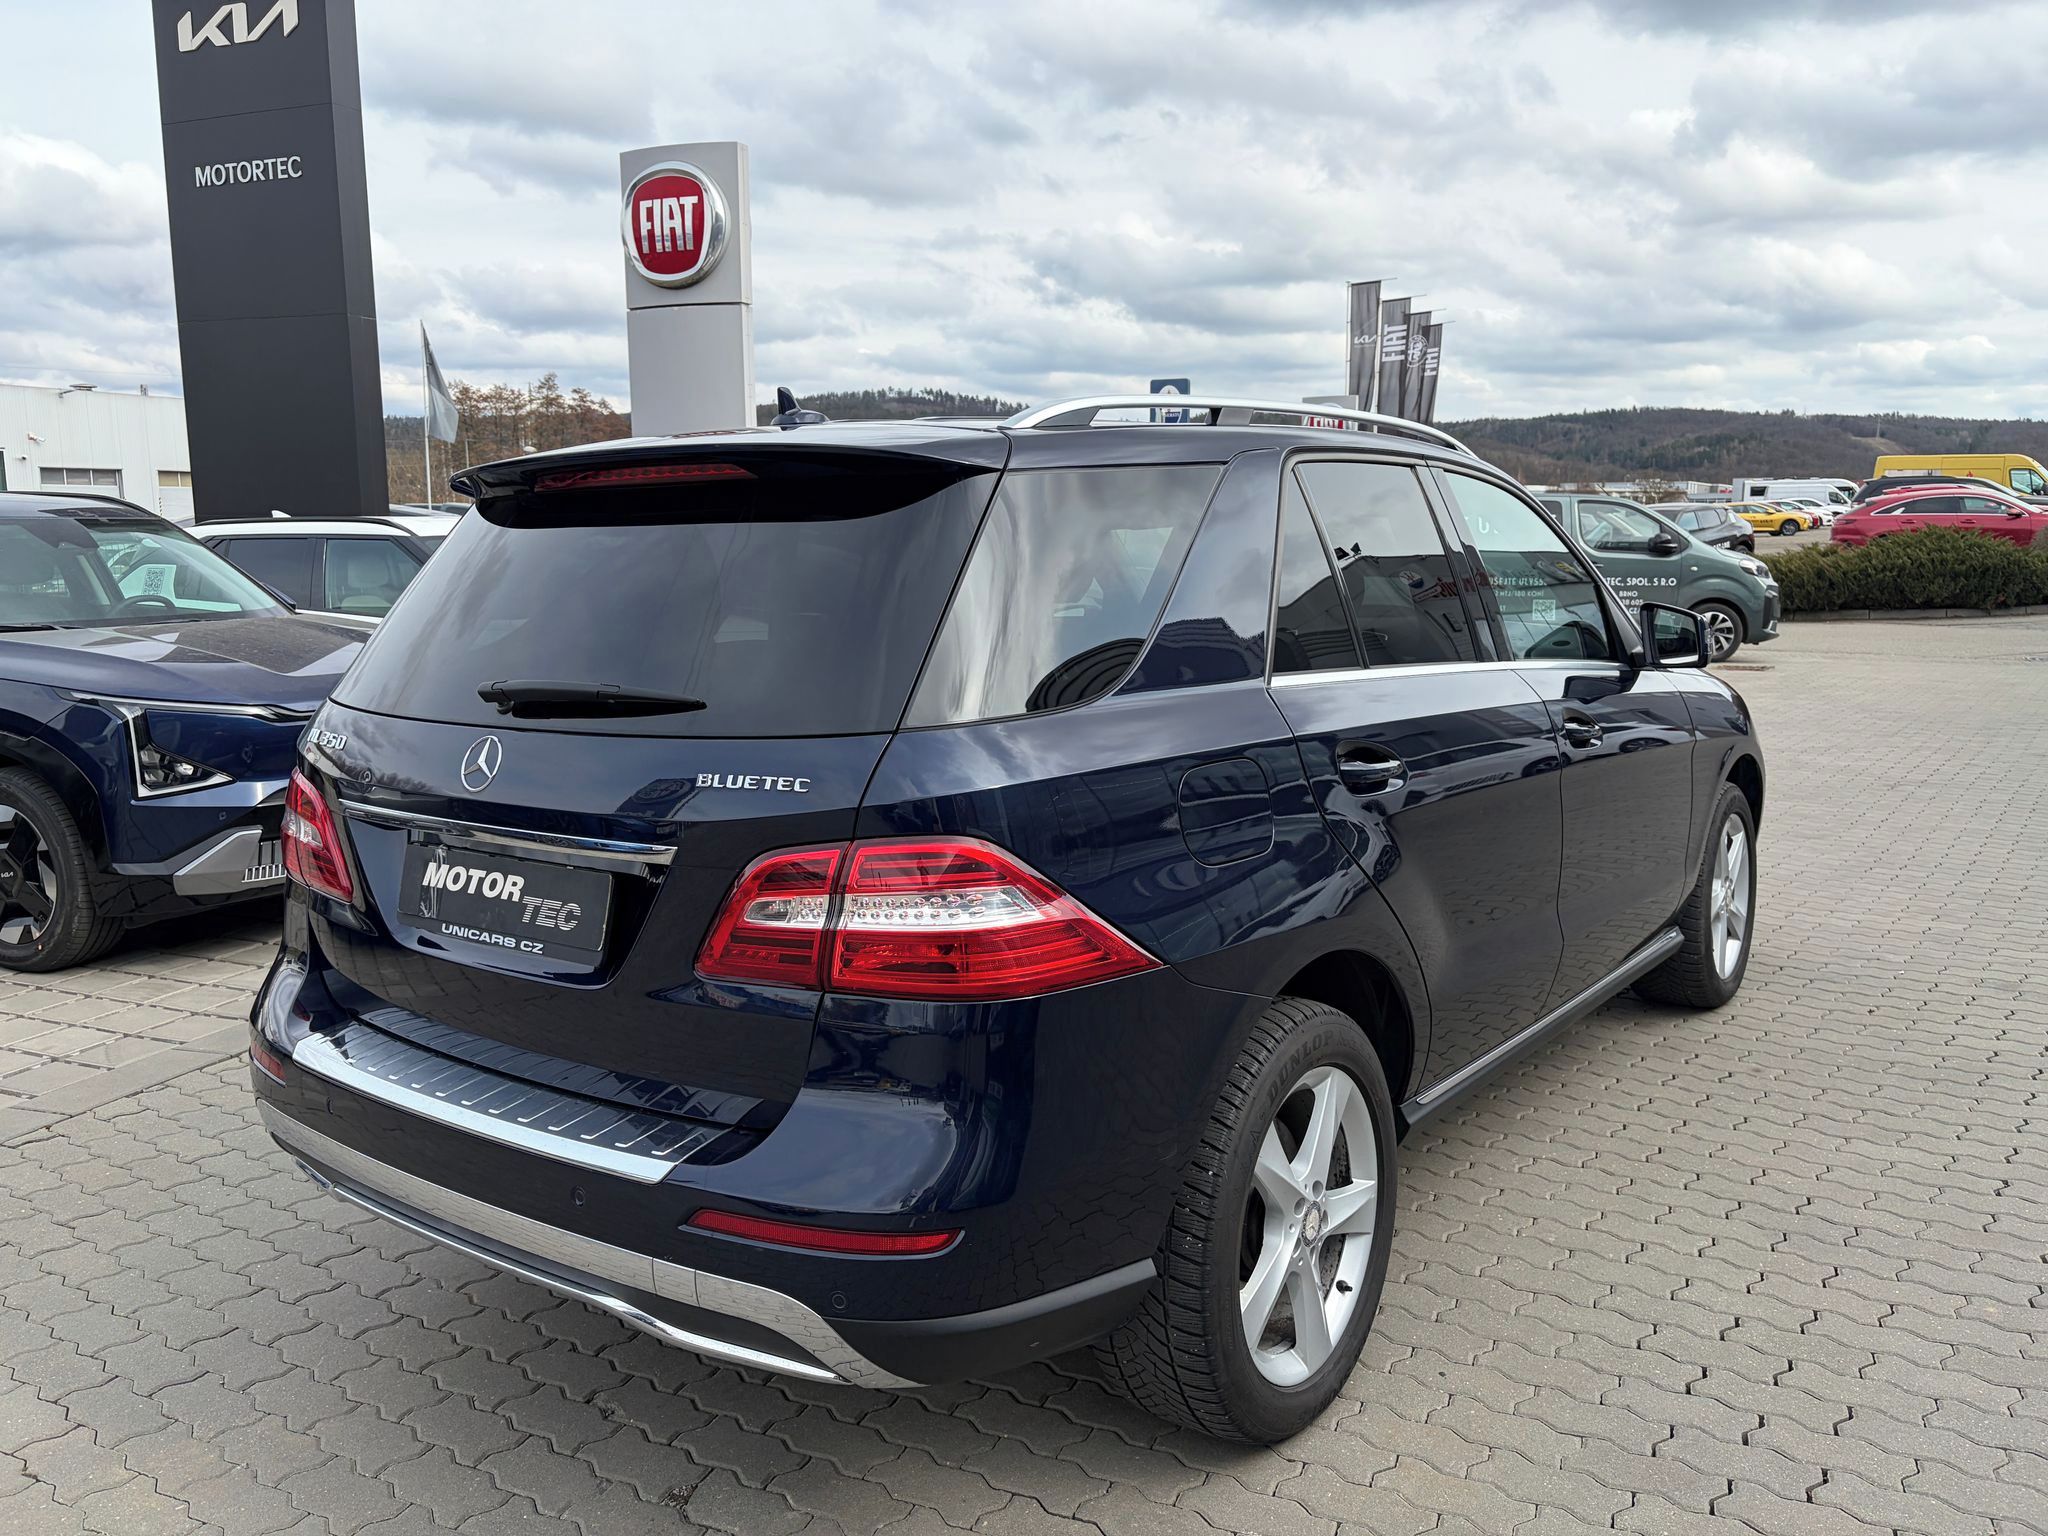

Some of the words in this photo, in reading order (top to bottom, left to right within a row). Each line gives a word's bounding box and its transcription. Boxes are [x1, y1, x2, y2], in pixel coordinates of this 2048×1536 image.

[177, 0, 299, 52] KIA
[194, 155, 303, 188] MOTORTEC
[640, 196, 699, 254] FIAT
[1381, 323, 1408, 362] FIAT
[1518, 576, 1548, 586] ULYSS
[1626, 577, 1651, 586] SPOL.
[1653, 577, 1659, 586] S
[319, 731, 348, 750] 350
[696, 773, 811, 793] BLUETEC
[422, 862, 525, 902] MOTOR
[521, 895, 582, 931] TEC
[441, 923, 516, 948] UNICARS
[520, 940, 544, 954] CZ
[1267, 1030, 1335, 1101] DUNLOP
